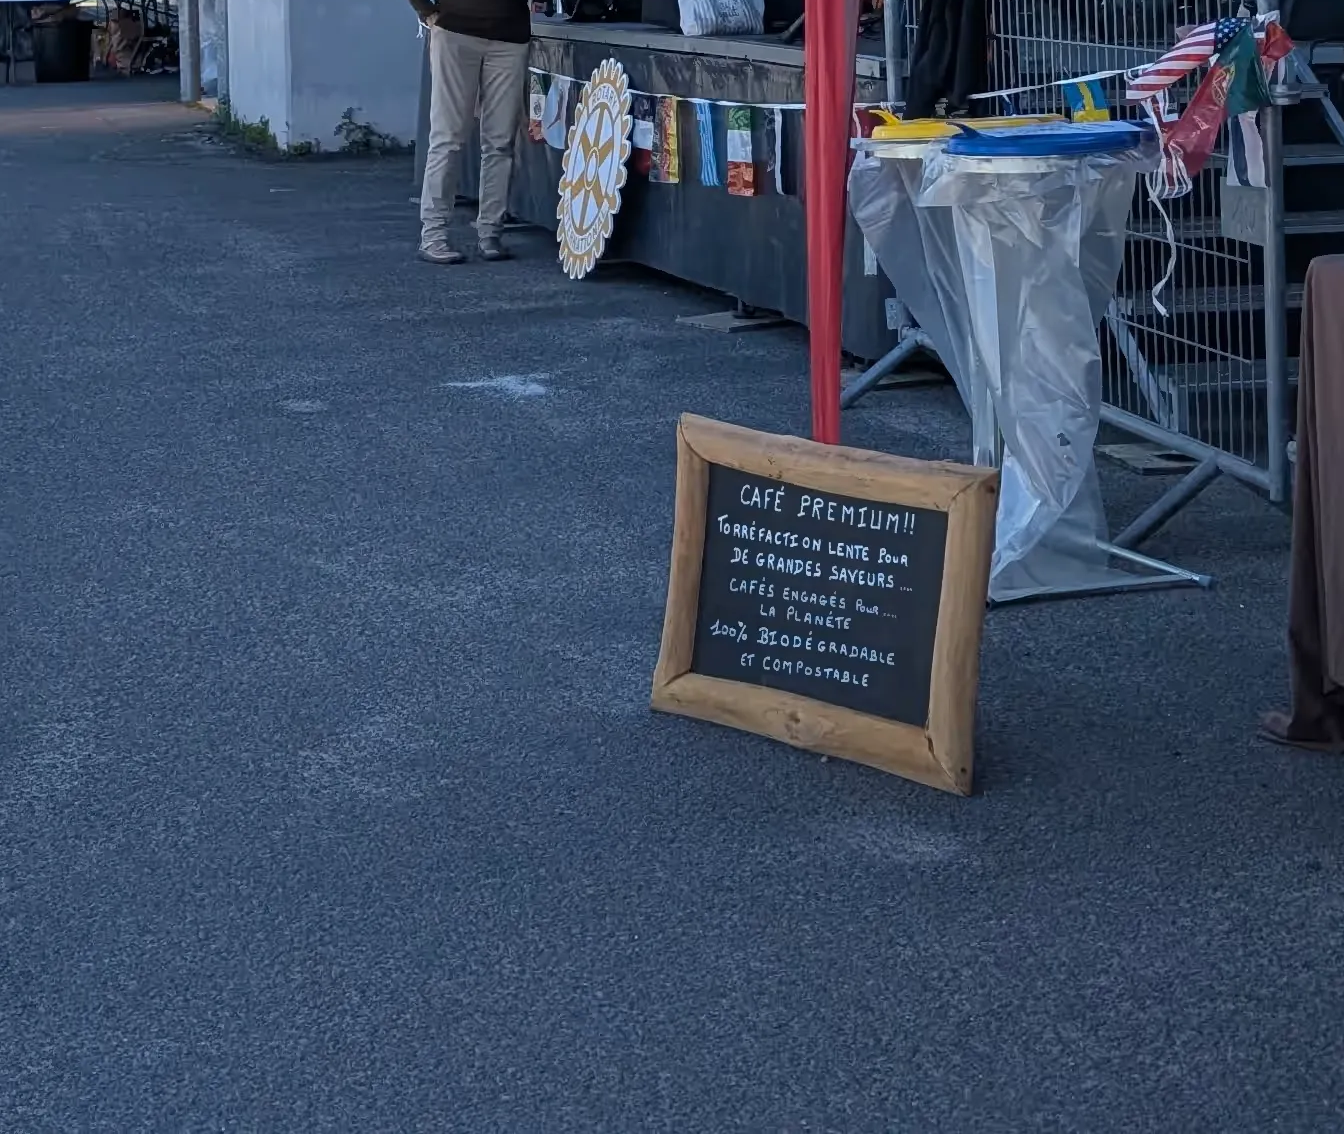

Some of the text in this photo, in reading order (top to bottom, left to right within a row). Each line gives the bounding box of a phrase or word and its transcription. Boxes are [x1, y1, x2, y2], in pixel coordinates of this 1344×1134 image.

[740, 484, 916, 535] CAFÉ PREMIUM!!
[730, 547, 749, 564] DE
[756, 553, 822, 578] GRANDES
[828, 541, 869, 563] LENTE
[729, 577, 775, 598] CAFÉS
[782, 587, 847, 610] ENGAGÉS
[759, 603, 776, 618] LA
[709, 618, 748, 643] 100%
[740, 652, 870, 688] ET COMPOSTABLE
